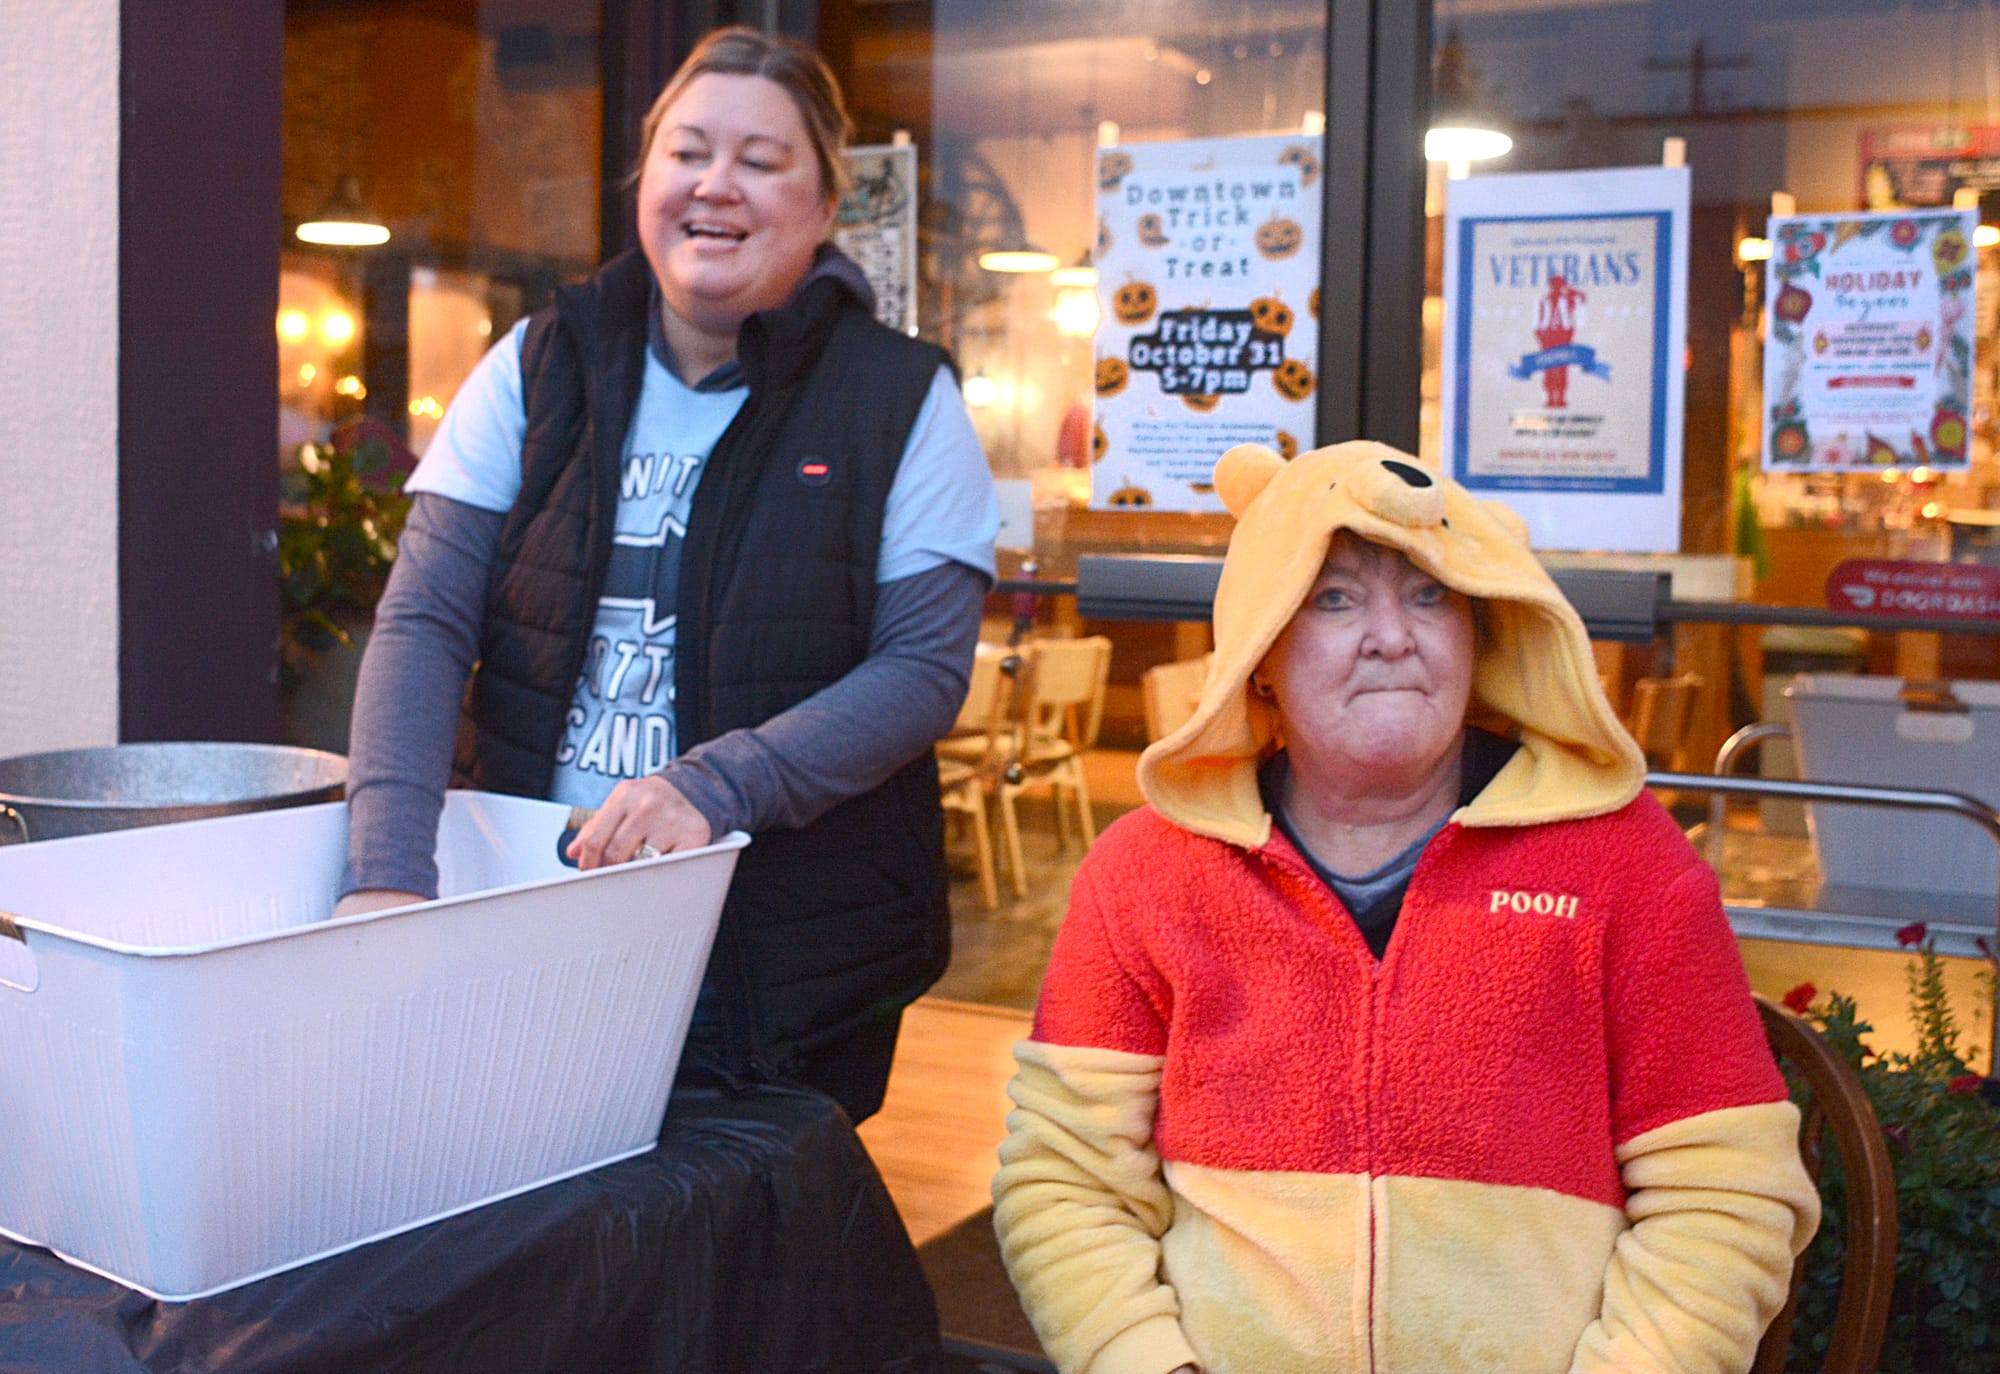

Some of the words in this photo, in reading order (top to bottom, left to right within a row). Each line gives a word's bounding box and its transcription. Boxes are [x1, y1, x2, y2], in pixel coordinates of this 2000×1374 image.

[1126, 181, 1296, 206] Downtown
[1166, 203, 1249, 227] Trick
[1165, 257, 1248, 279] Treat
[1490, 252, 1639, 286] VETERANS
[1825, 269, 1922, 292] HOLIDAY
[1531, 287, 1586, 333] DAY
[1160, 315, 1252, 347] Friday
[1130, 341, 1241, 366] October
[1248, 341, 1281, 366] 31
[1161, 367, 1248, 394] 5-7pm
[1489, 890, 1579, 919] POOH
